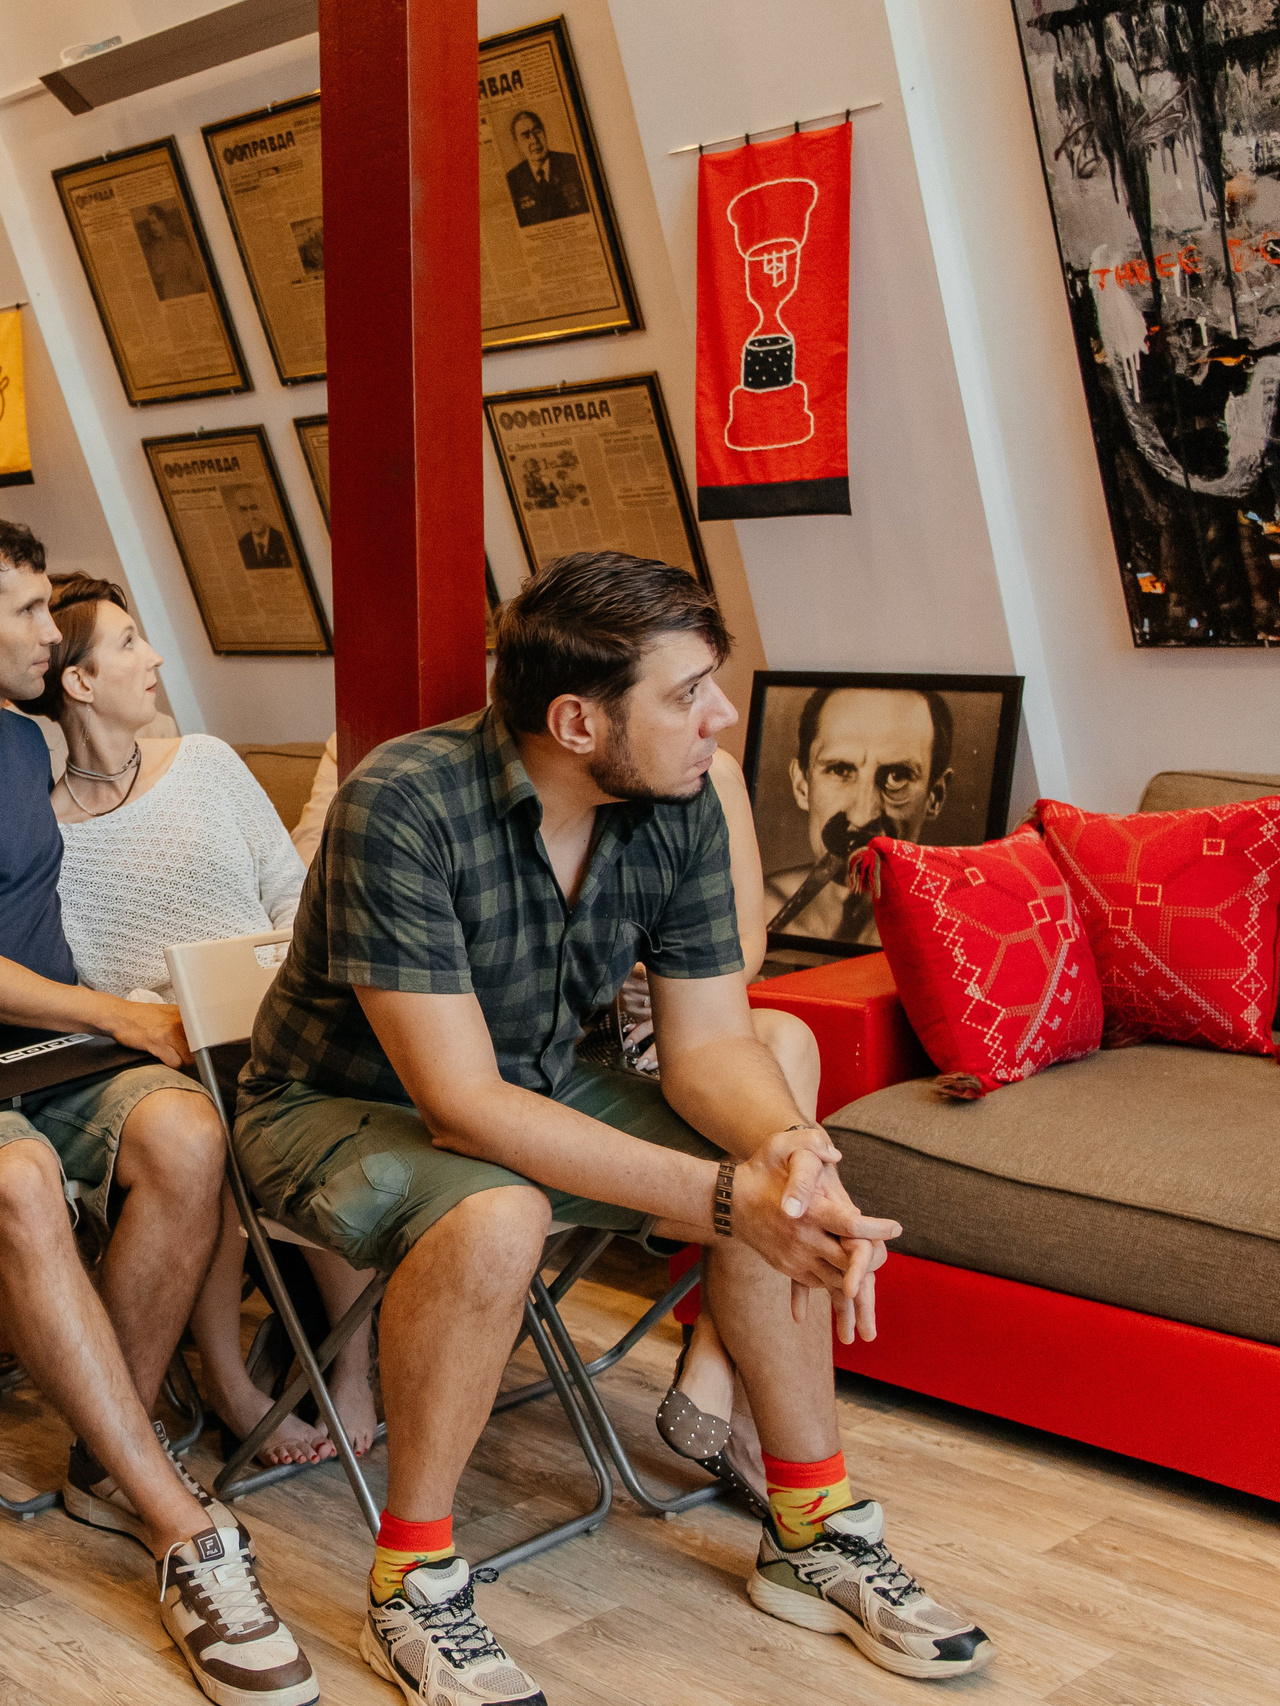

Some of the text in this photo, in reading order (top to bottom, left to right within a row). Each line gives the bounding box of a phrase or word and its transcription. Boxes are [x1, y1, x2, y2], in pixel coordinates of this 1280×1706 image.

[242, 131, 296, 161] ПРАВДА
[1092, 245, 1202, 290] THREE
[540, 400, 611, 425] ПРАВДА
[191, 457, 240, 475] ПРАВДА
